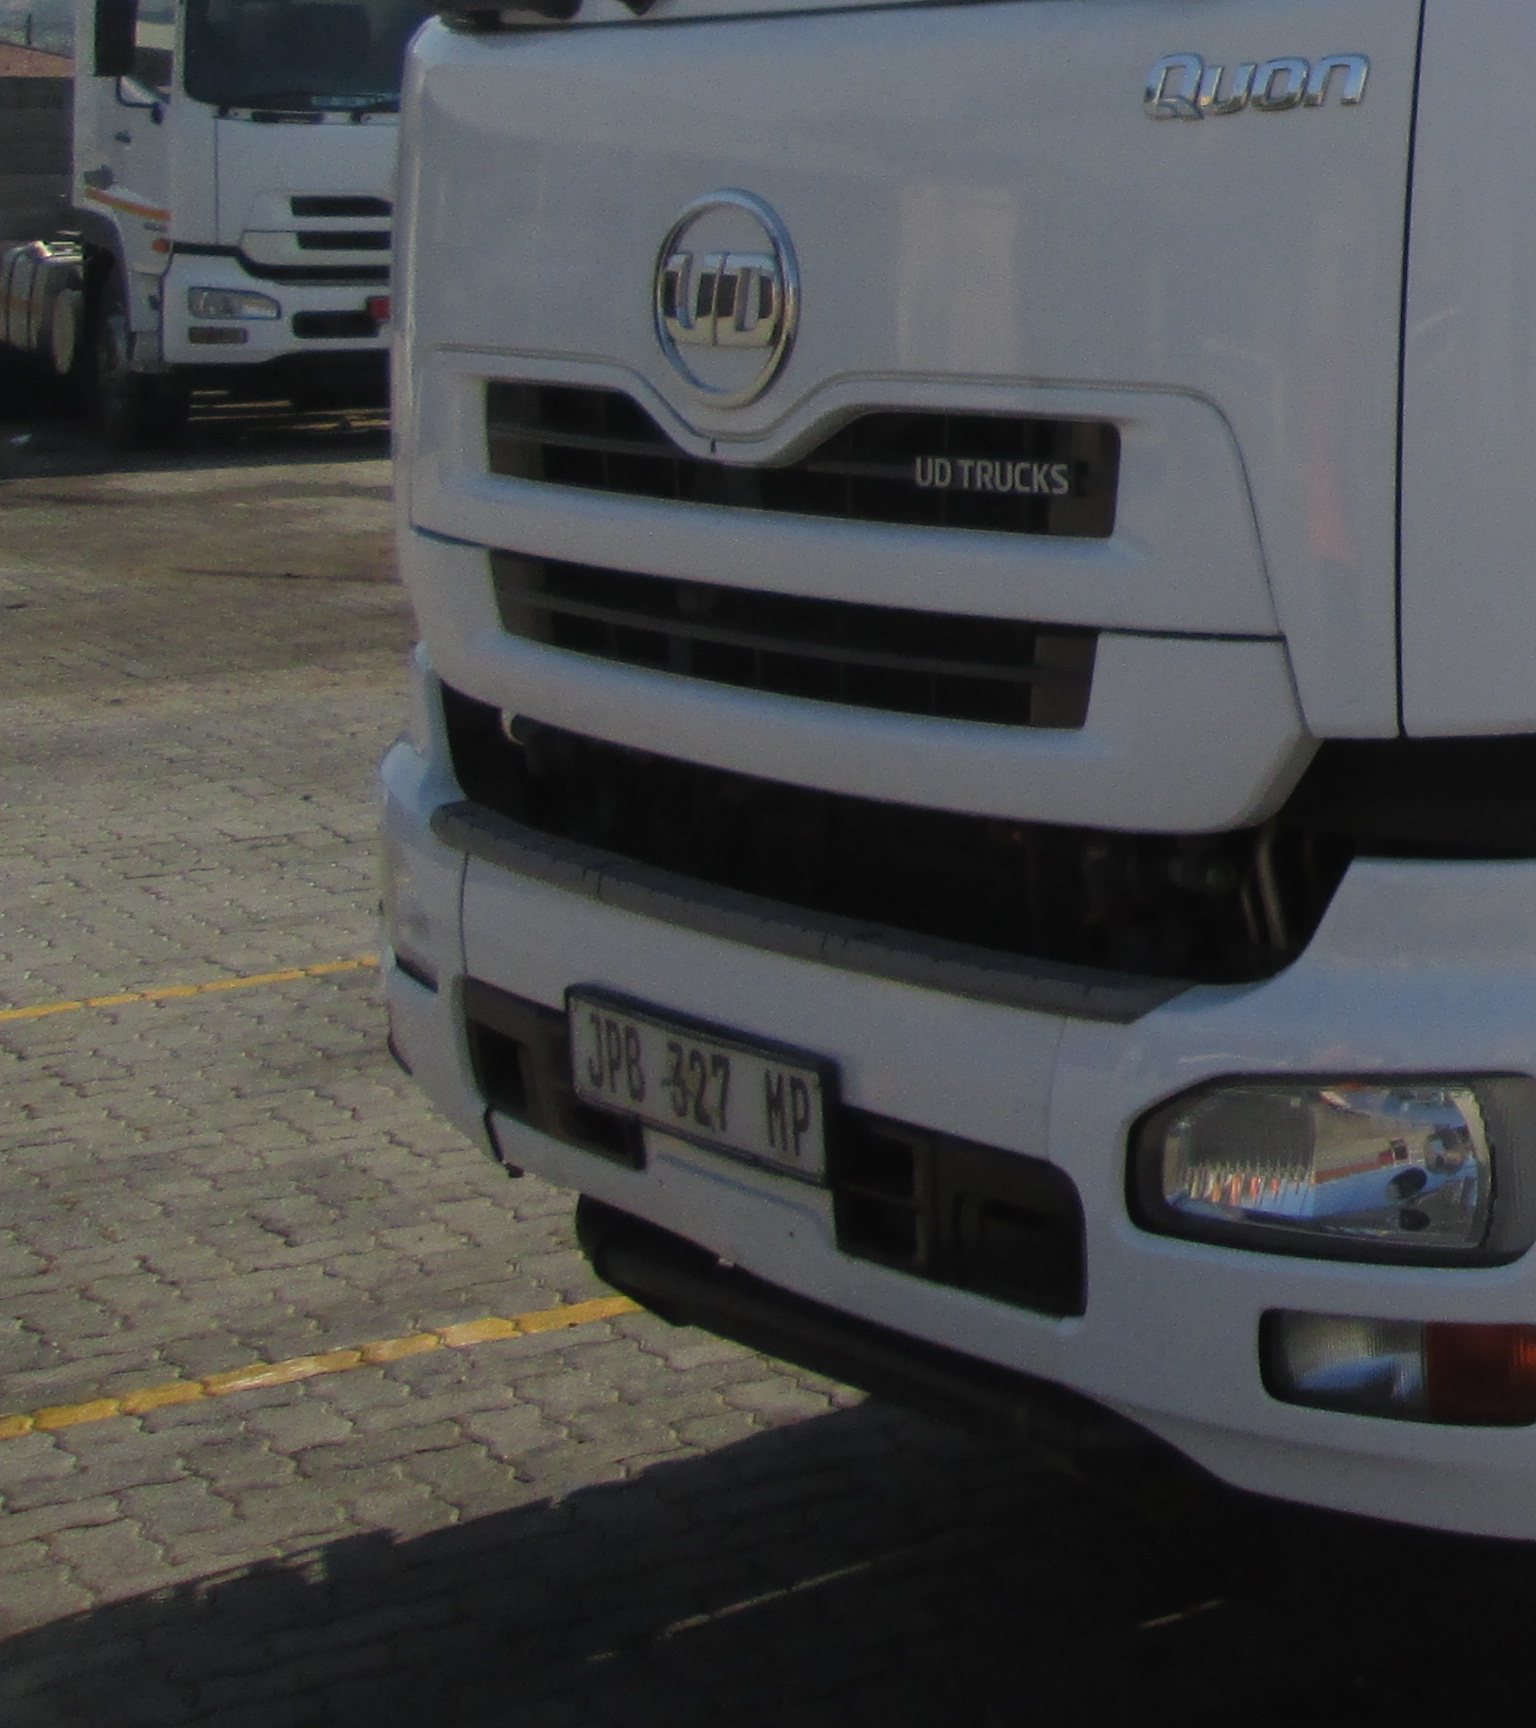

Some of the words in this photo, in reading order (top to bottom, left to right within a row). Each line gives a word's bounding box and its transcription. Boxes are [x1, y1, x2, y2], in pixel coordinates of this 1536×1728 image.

[1144, 51, 1371, 121] Quon
[662, 250, 780, 346] UD
[914, 456, 952, 488] UD
[957, 458, 1070, 495] TRUCKS
[588, 1012, 646, 1104] JPB
[763, 1068, 811, 1157] MP
